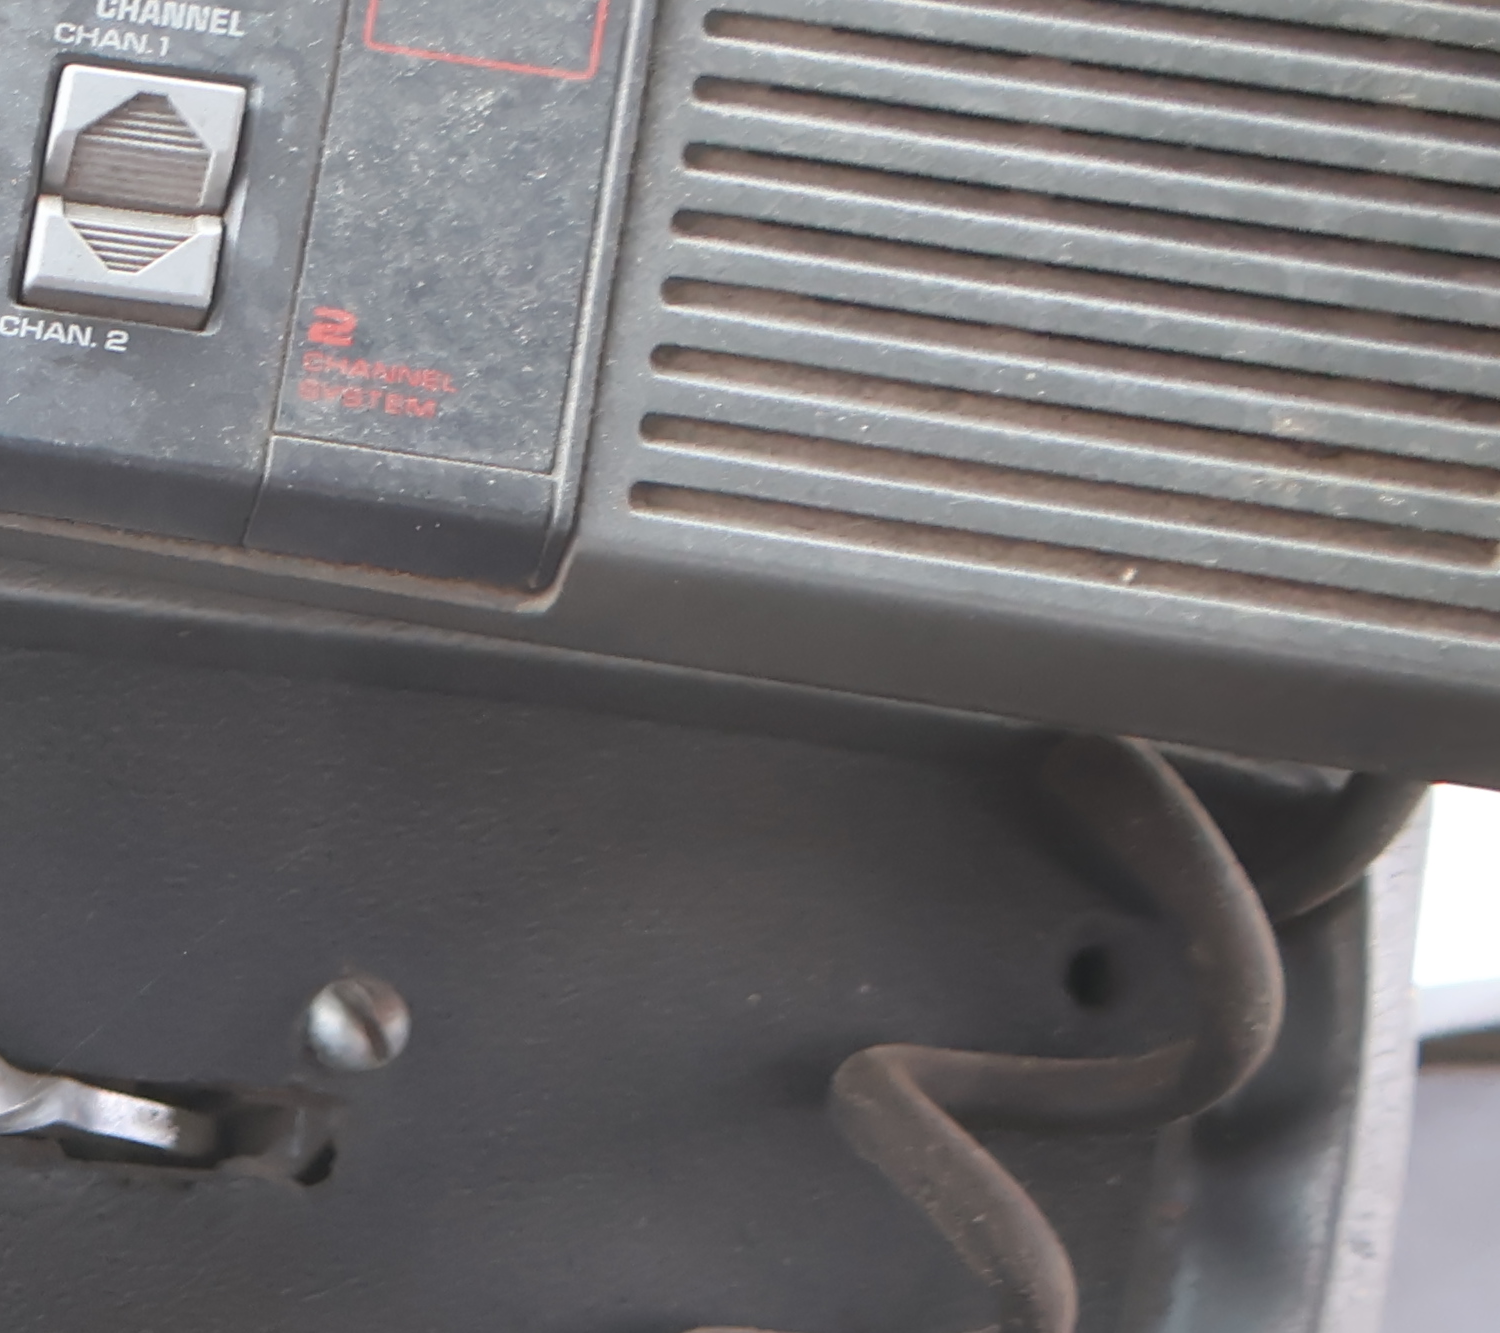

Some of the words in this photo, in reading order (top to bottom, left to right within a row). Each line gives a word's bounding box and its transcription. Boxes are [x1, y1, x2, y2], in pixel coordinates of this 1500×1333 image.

[96, 0, 245, 37] CHANNEL
[103, 329, 130, 352] 2
[307, 306, 358, 347] 2
